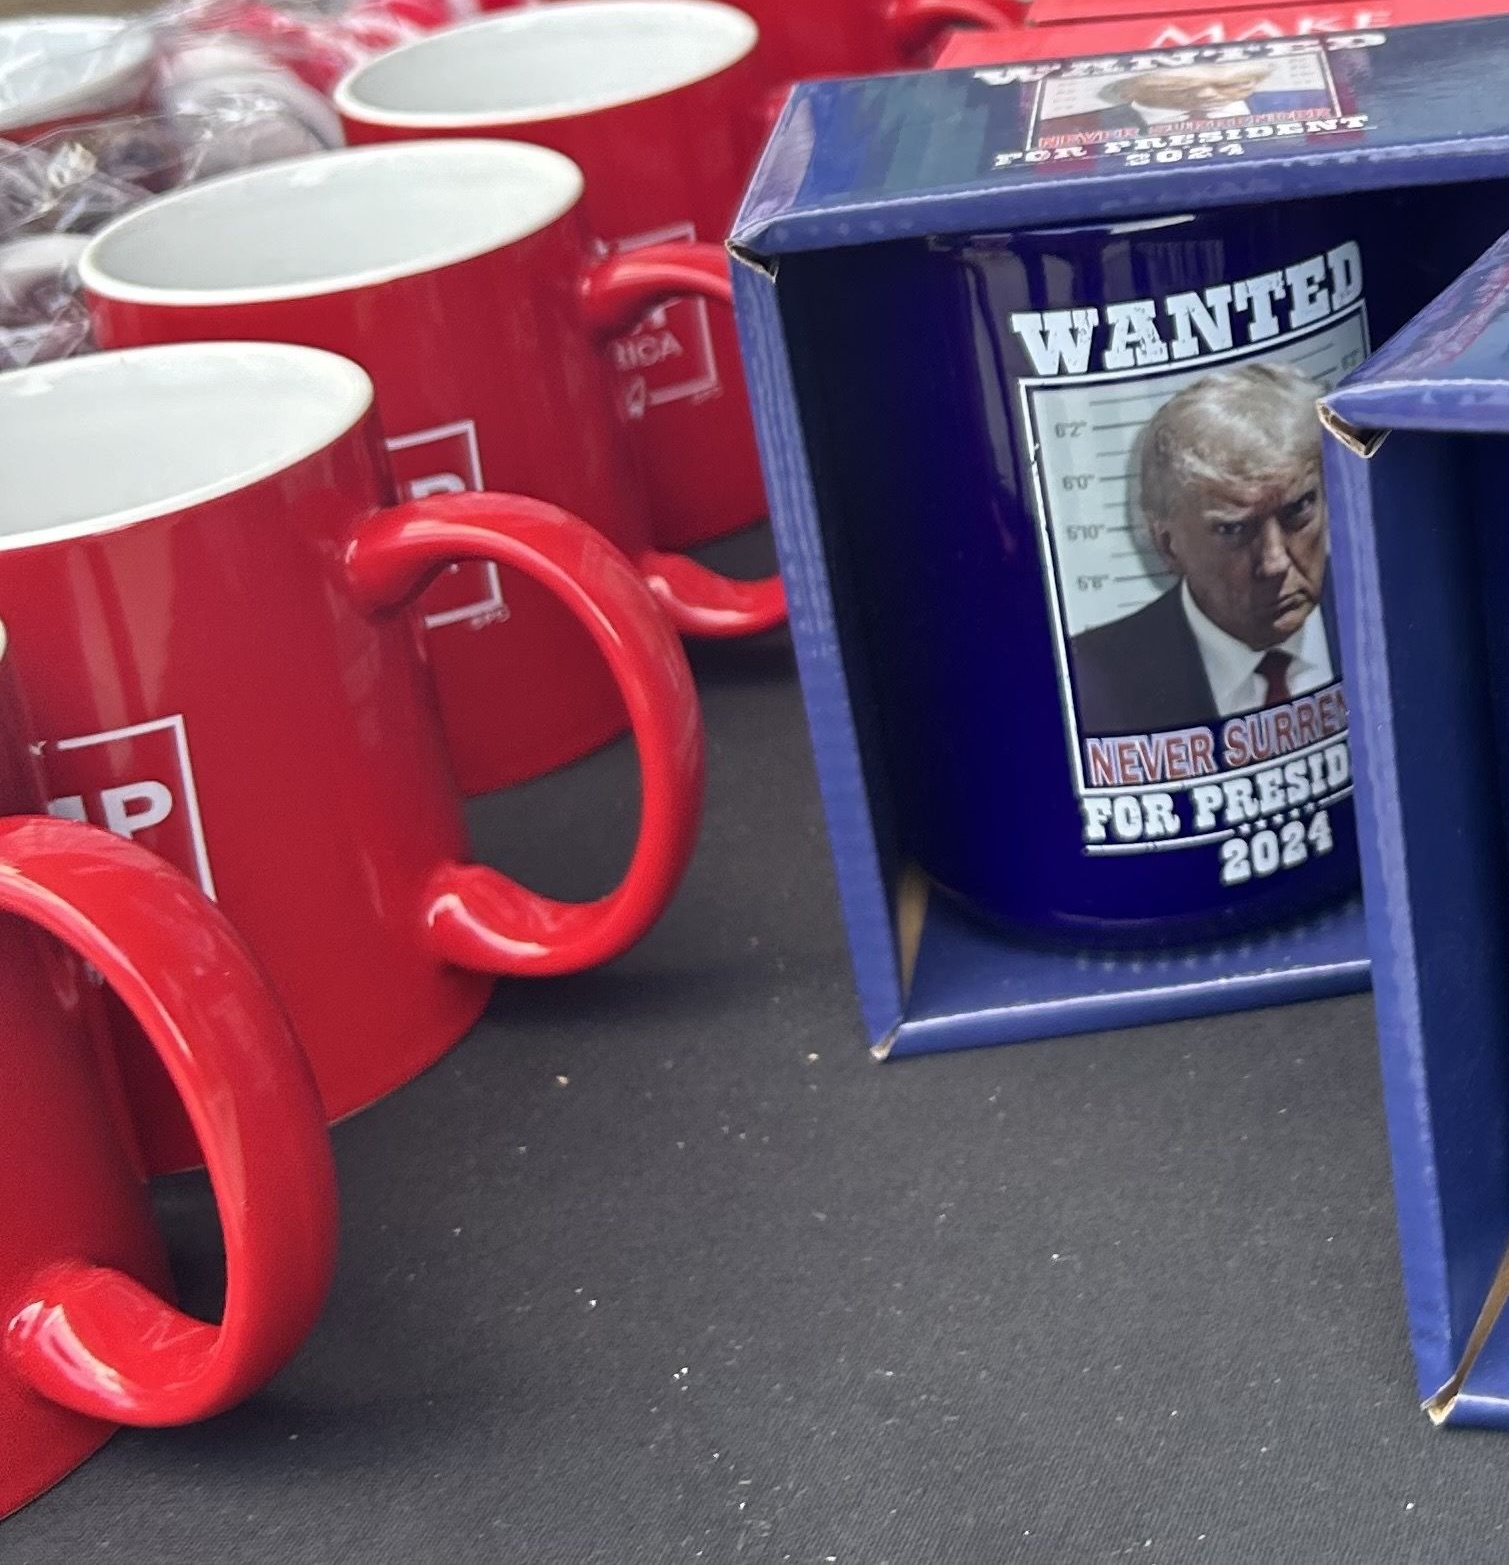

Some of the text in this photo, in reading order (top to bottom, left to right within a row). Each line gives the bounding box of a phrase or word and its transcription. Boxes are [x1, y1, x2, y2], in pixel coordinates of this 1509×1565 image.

[1150, 10, 1393, 50] MAKE
[974, 33, 1387, 86] WANTED
[993, 115, 1370, 169] FOR PRESIDENT
[1125, 142, 1246, 167] 2024
[1010, 240, 1364, 376] WANTED
[1084, 726, 1218, 787] NEVER
[1082, 741, 1350, 843] FOR PRESID
[1219, 809, 1334, 885] 2024
